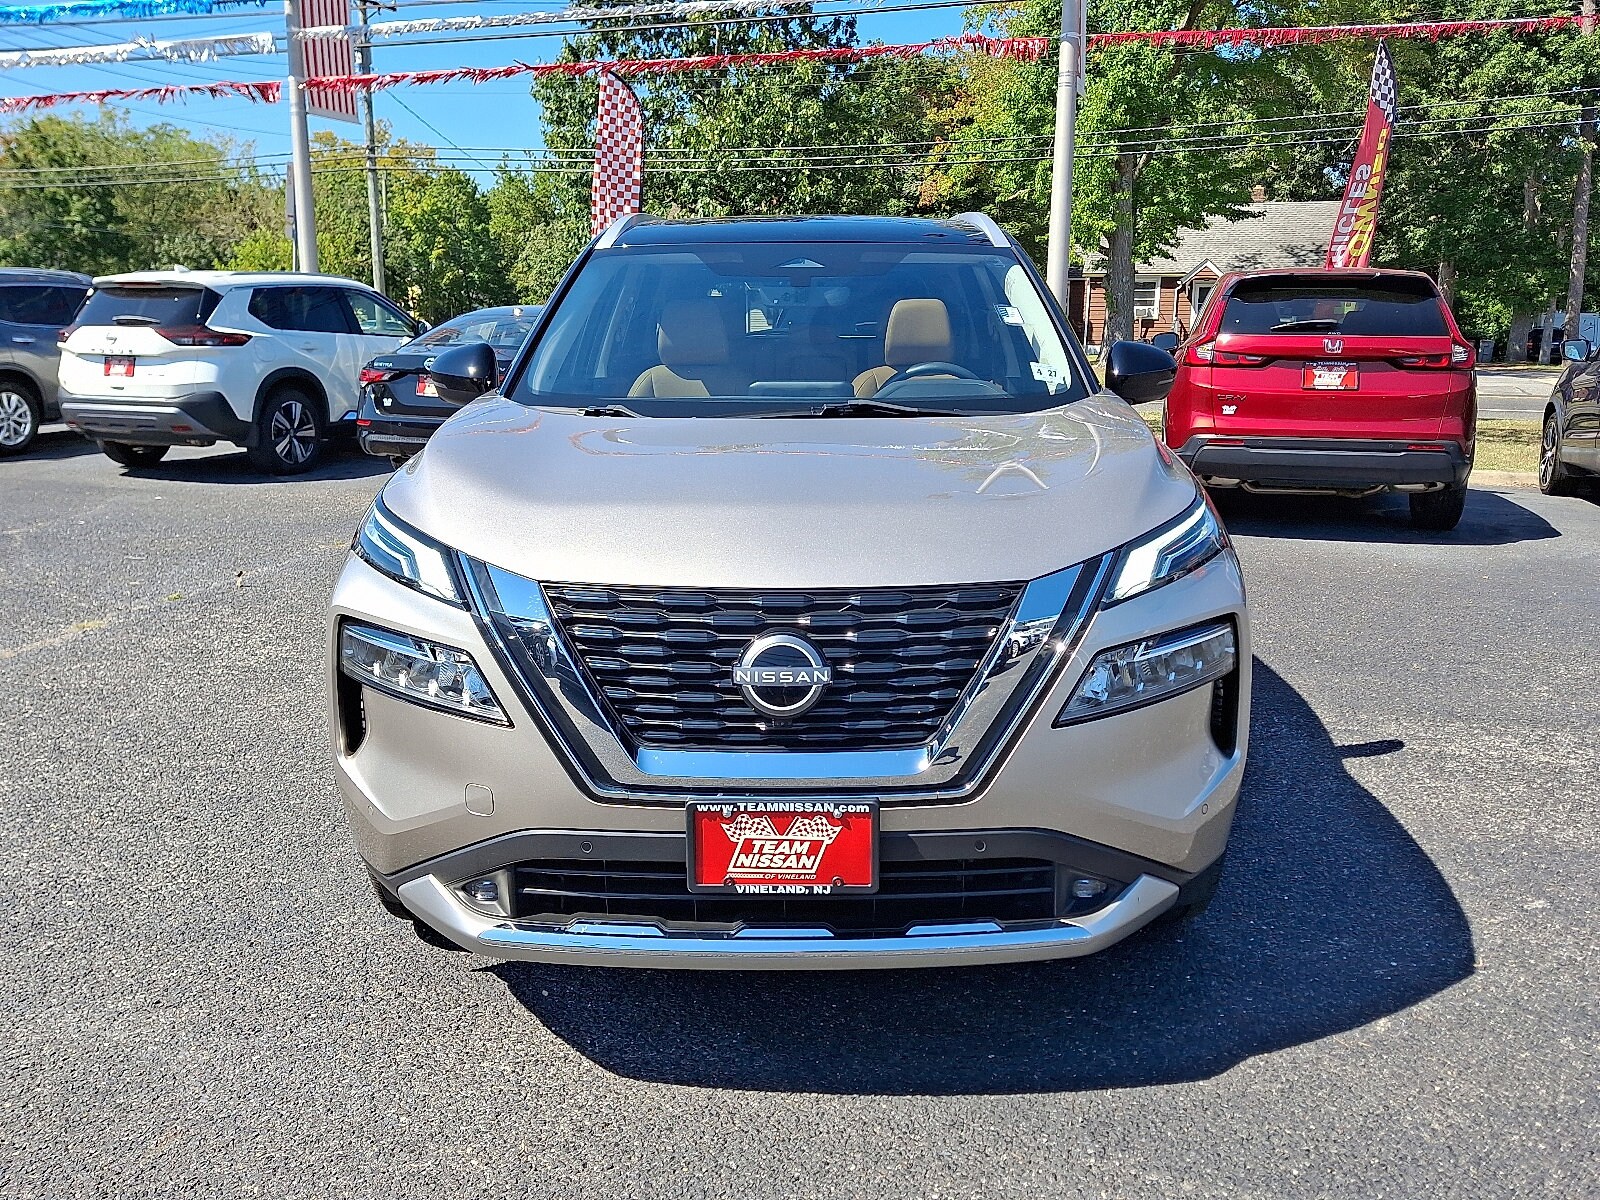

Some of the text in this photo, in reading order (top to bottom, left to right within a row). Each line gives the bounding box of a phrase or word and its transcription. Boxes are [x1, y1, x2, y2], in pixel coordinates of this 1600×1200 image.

[1047, 369, 1056, 377] 27
[735, 670, 828, 683] NISSAN
[697, 802, 869, 813] www.TEAMNISSAN.com
[751, 840, 811, 854] TEAM
[736, 854, 816, 868] NISSAN
[735, 885, 831, 895] VINELAND, NJ
